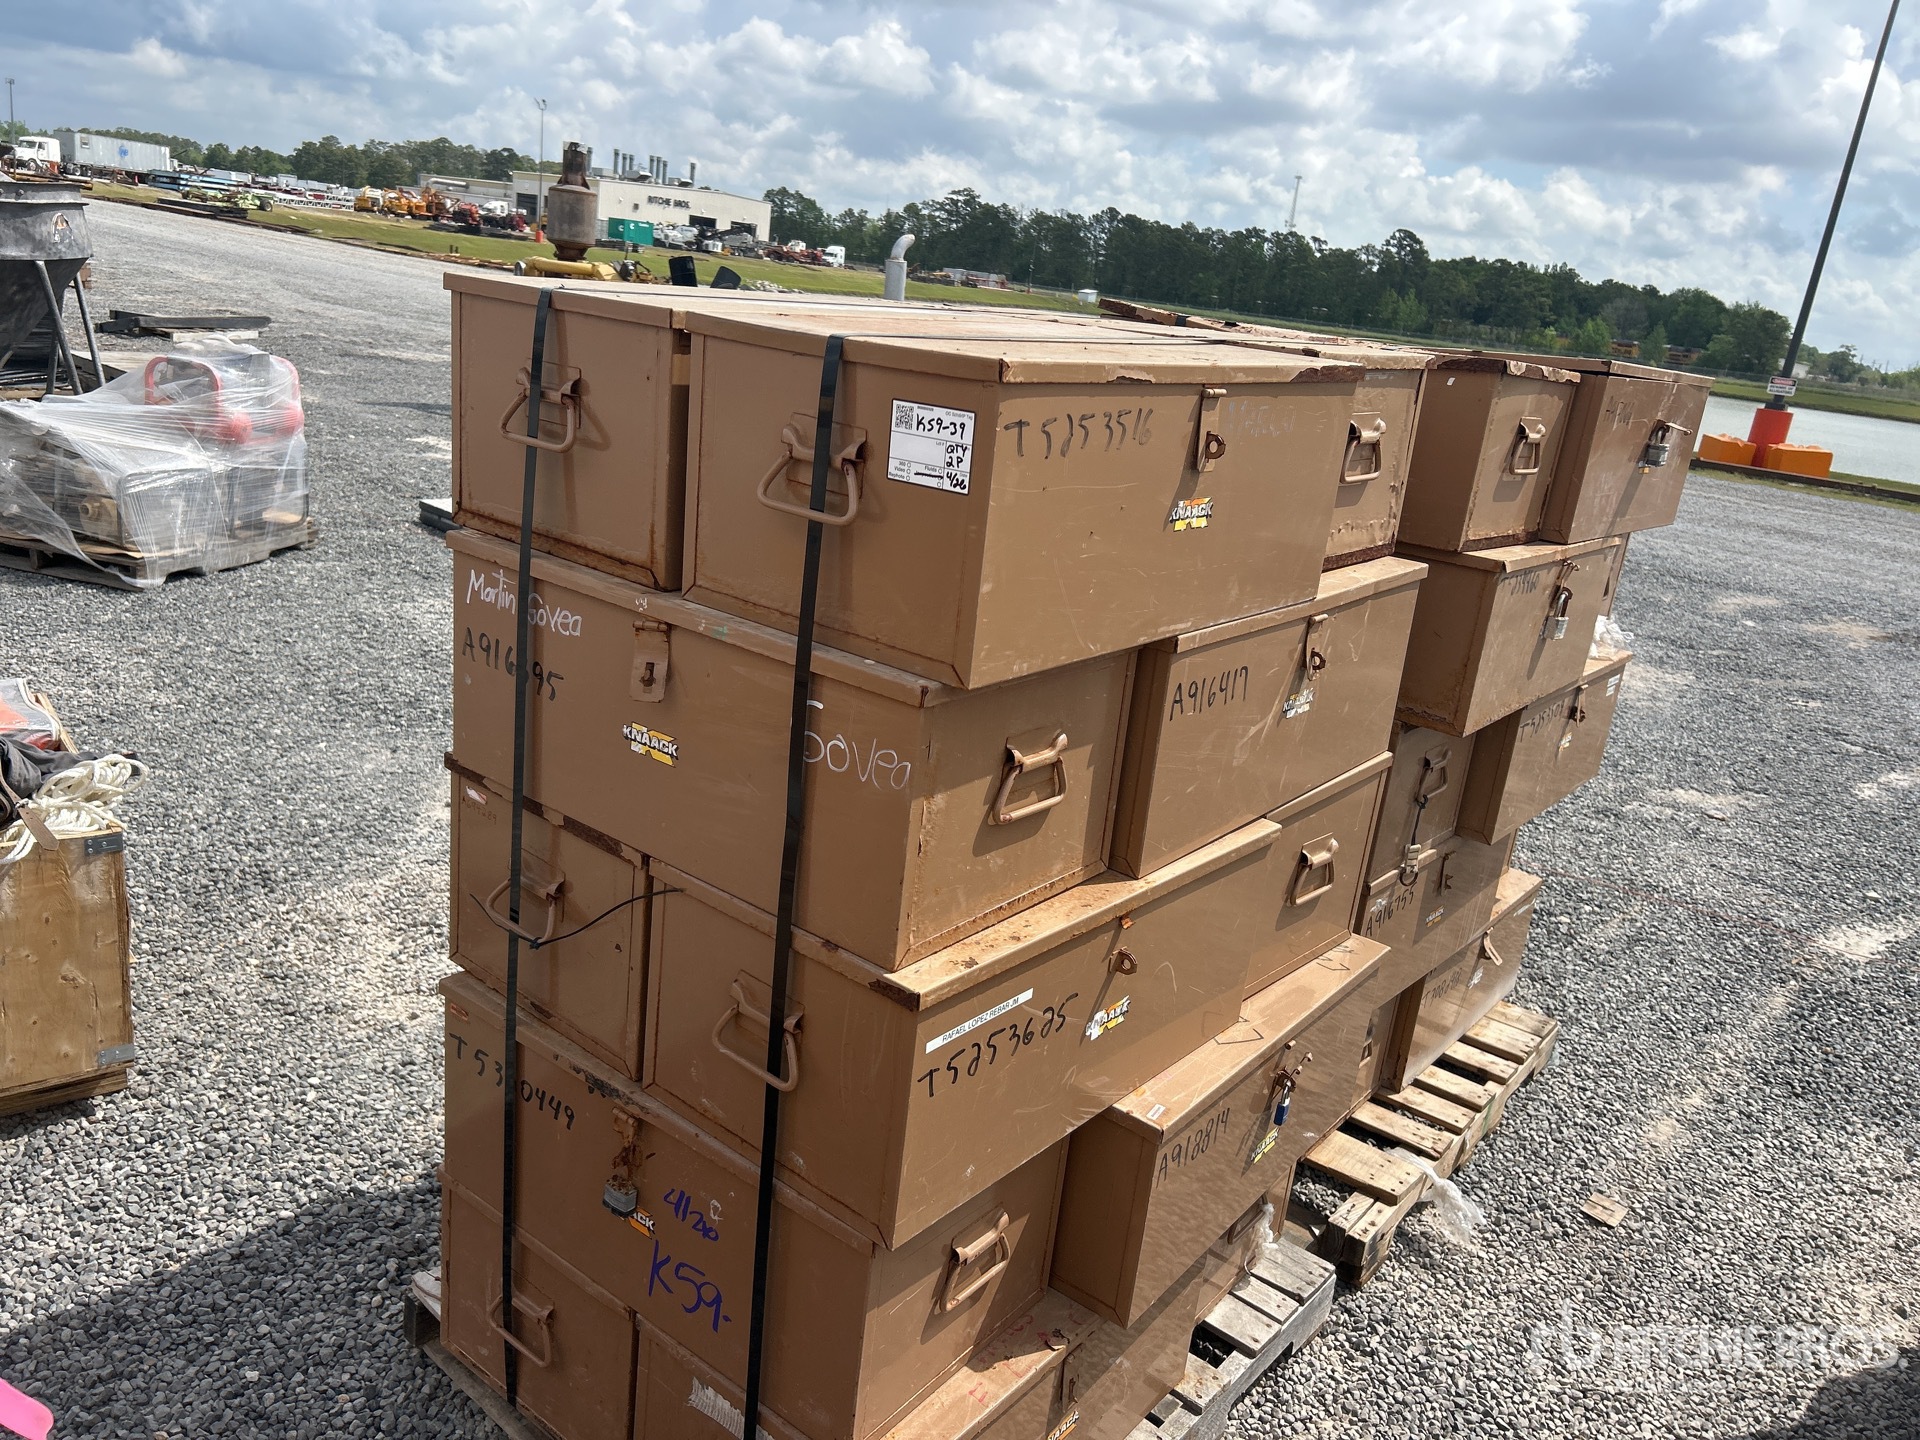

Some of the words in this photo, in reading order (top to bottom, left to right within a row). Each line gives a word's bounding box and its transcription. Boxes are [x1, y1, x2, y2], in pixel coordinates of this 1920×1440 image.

[648, 195, 671, 206] RITCHIE
[916, 413, 966, 440] K59-39
[946, 444, 968, 458] QTY
[1169, 502, 1213, 523] KNAACK
[466, 569, 516, 615] Martin
[461, 627, 565, 701] A91695
[1169, 665, 1249, 722] A916417
[622, 724, 679, 761] KNAACK
[942, 1025, 966, 1043] RAFAEL
[967, 1012, 989, 1030] LOPEZ
[989, 1001, 1010, 1019] REBAR
[1156, 1107, 1231, 1190] A918814
